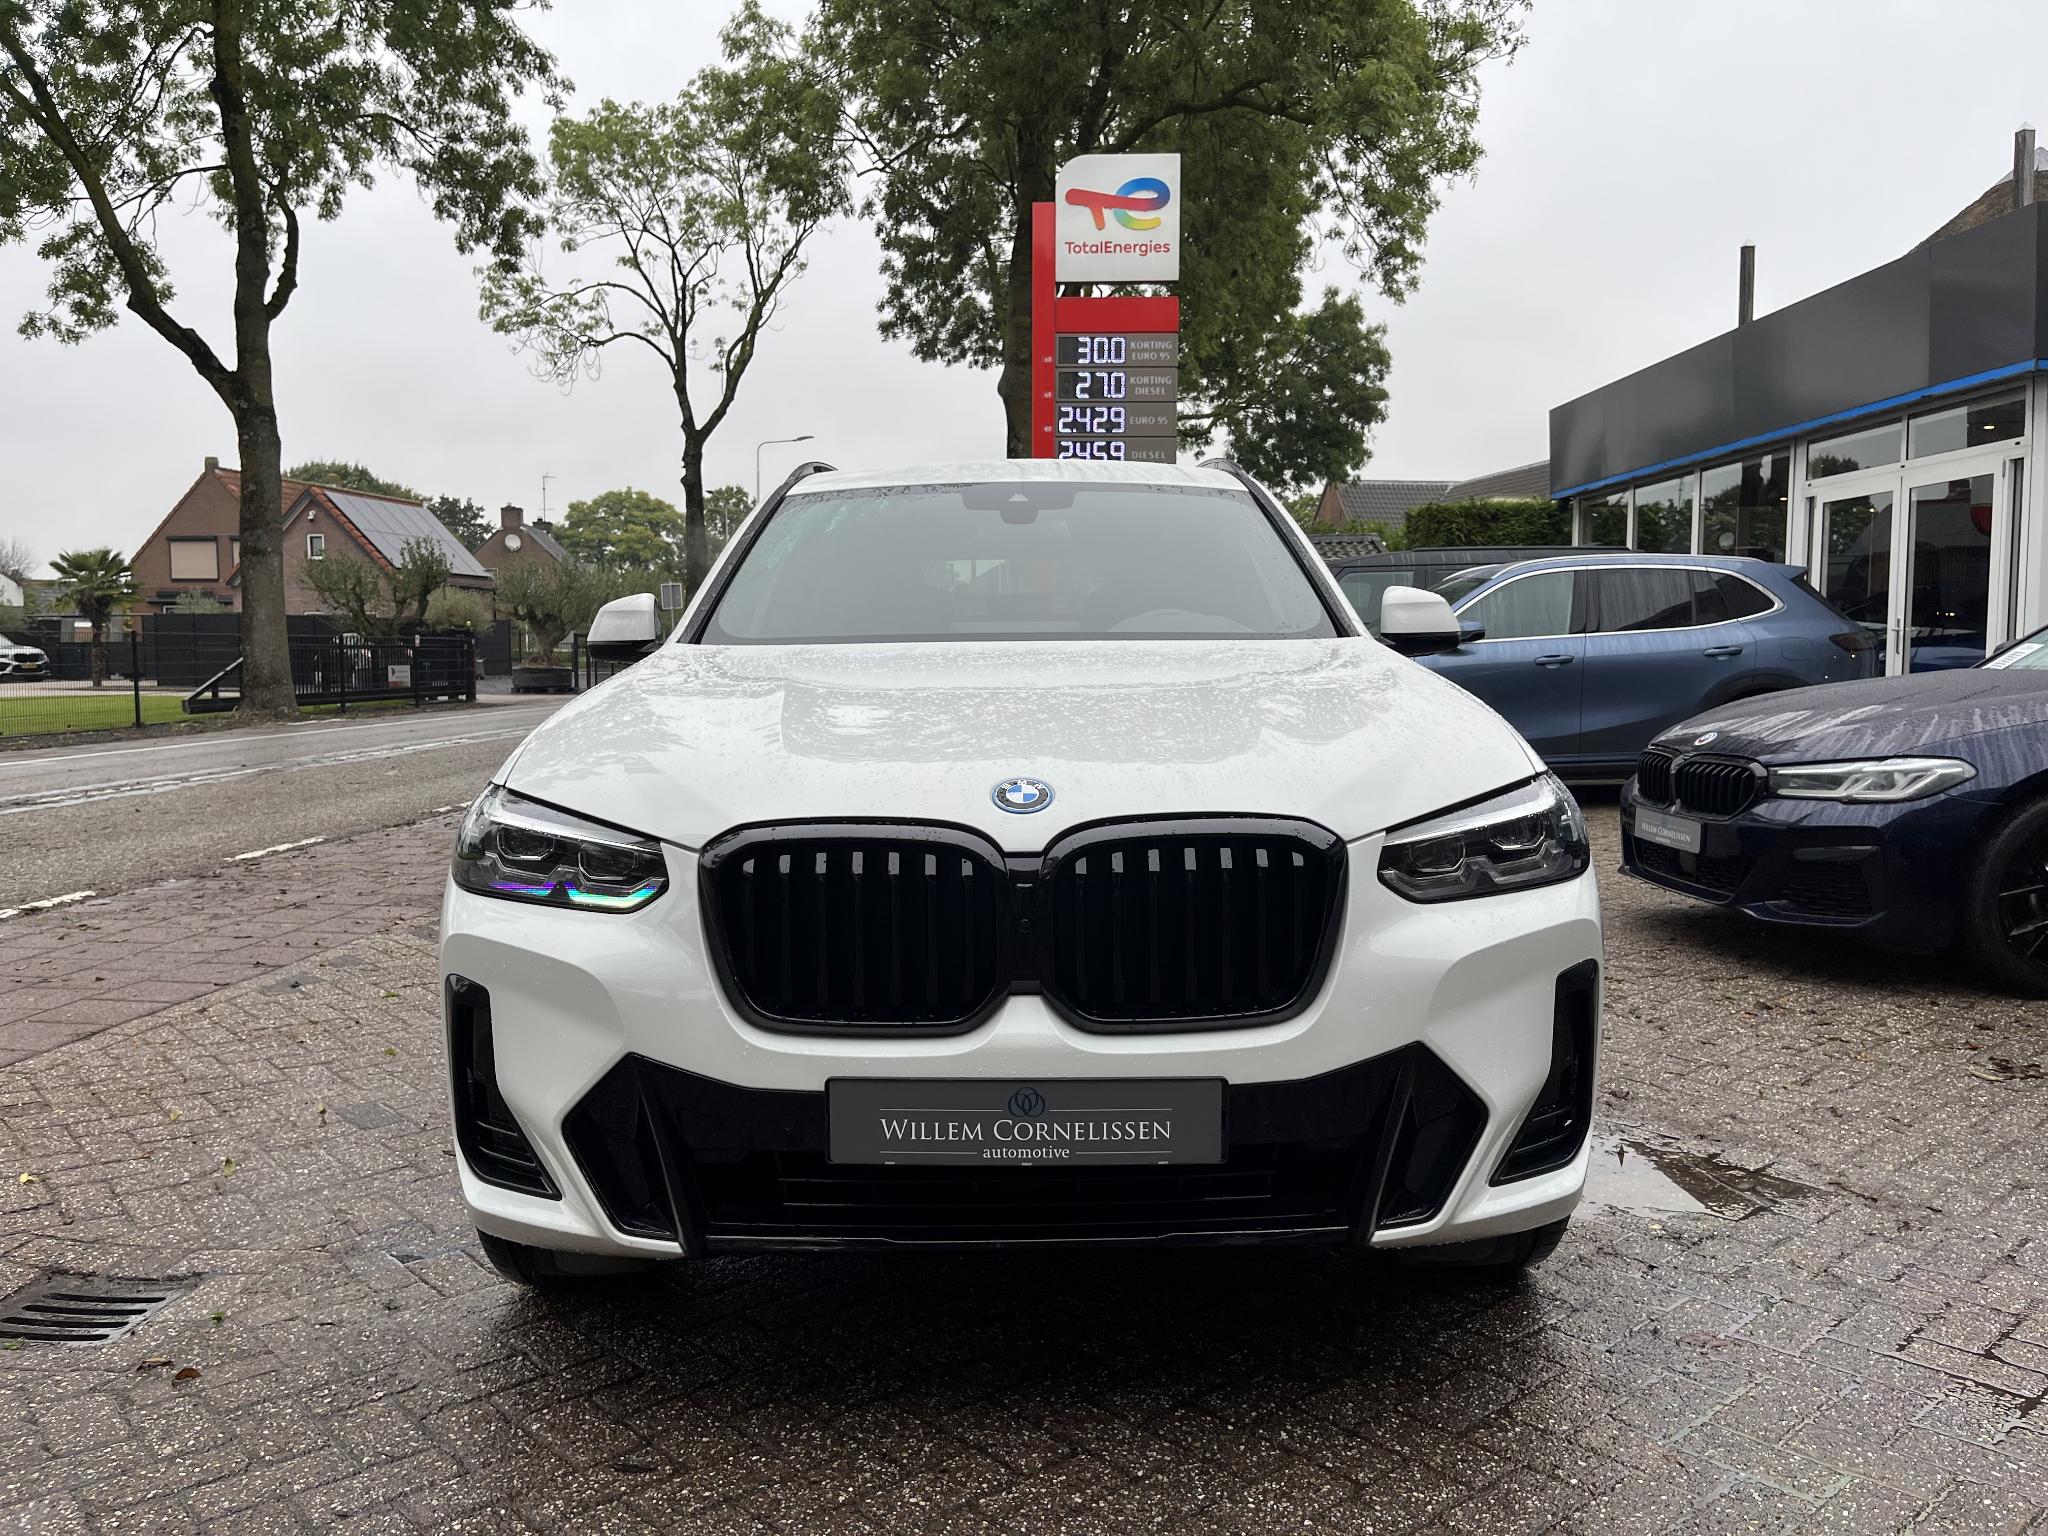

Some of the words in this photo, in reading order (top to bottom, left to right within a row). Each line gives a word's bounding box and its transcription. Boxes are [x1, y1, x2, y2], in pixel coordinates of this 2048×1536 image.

[1065, 240, 1170, 256] TotalEnergies
[1130, 341, 1172, 349] KORTING
[1132, 352, 1156, 360] EURO
[1160, 352, 1170, 360] 95
[1129, 376, 1172, 384] KORTING
[1135, 387, 1165, 395] DIESEL
[1129, 416, 1155, 424] EURO
[1158, 416, 1168, 424] 95
[1131, 451, 1166, 459] DIESEL
[880, 1118, 984, 1141] WILLEM
[993, 1118, 1172, 1141] CORNELISSEN
[983, 1146, 1070, 1159] automotive
